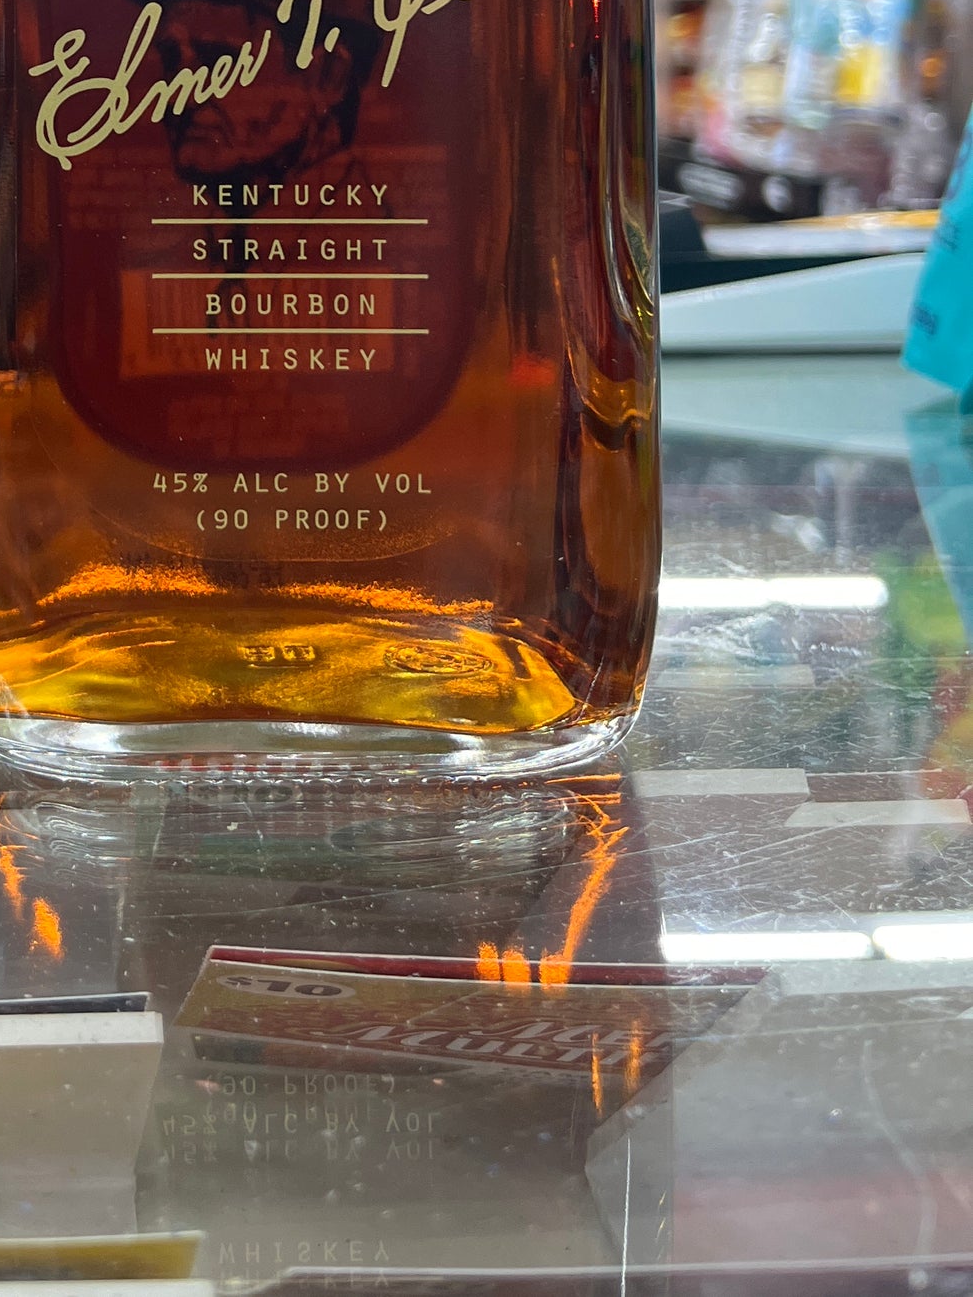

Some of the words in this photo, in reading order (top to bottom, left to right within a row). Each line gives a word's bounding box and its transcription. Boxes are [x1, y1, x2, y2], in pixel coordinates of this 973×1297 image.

[29, 2, 271, 171] Elmer
[192, 184, 390, 207] KENTUCKY
[192, 239, 388, 262] STRAIGHT
[205, 294, 376, 316] BOURBON
[205, 348, 377, 371] WHISKEY
[153, 472, 209, 494] 45%
[233, 472, 289, 494] ALC
[315, 472, 350, 494] BY
[374, 473, 432, 495] VOL
[195, 509, 250, 532] (90
[275, 509, 388, 533] PROOF)
[226, 975, 343, 997] $10
